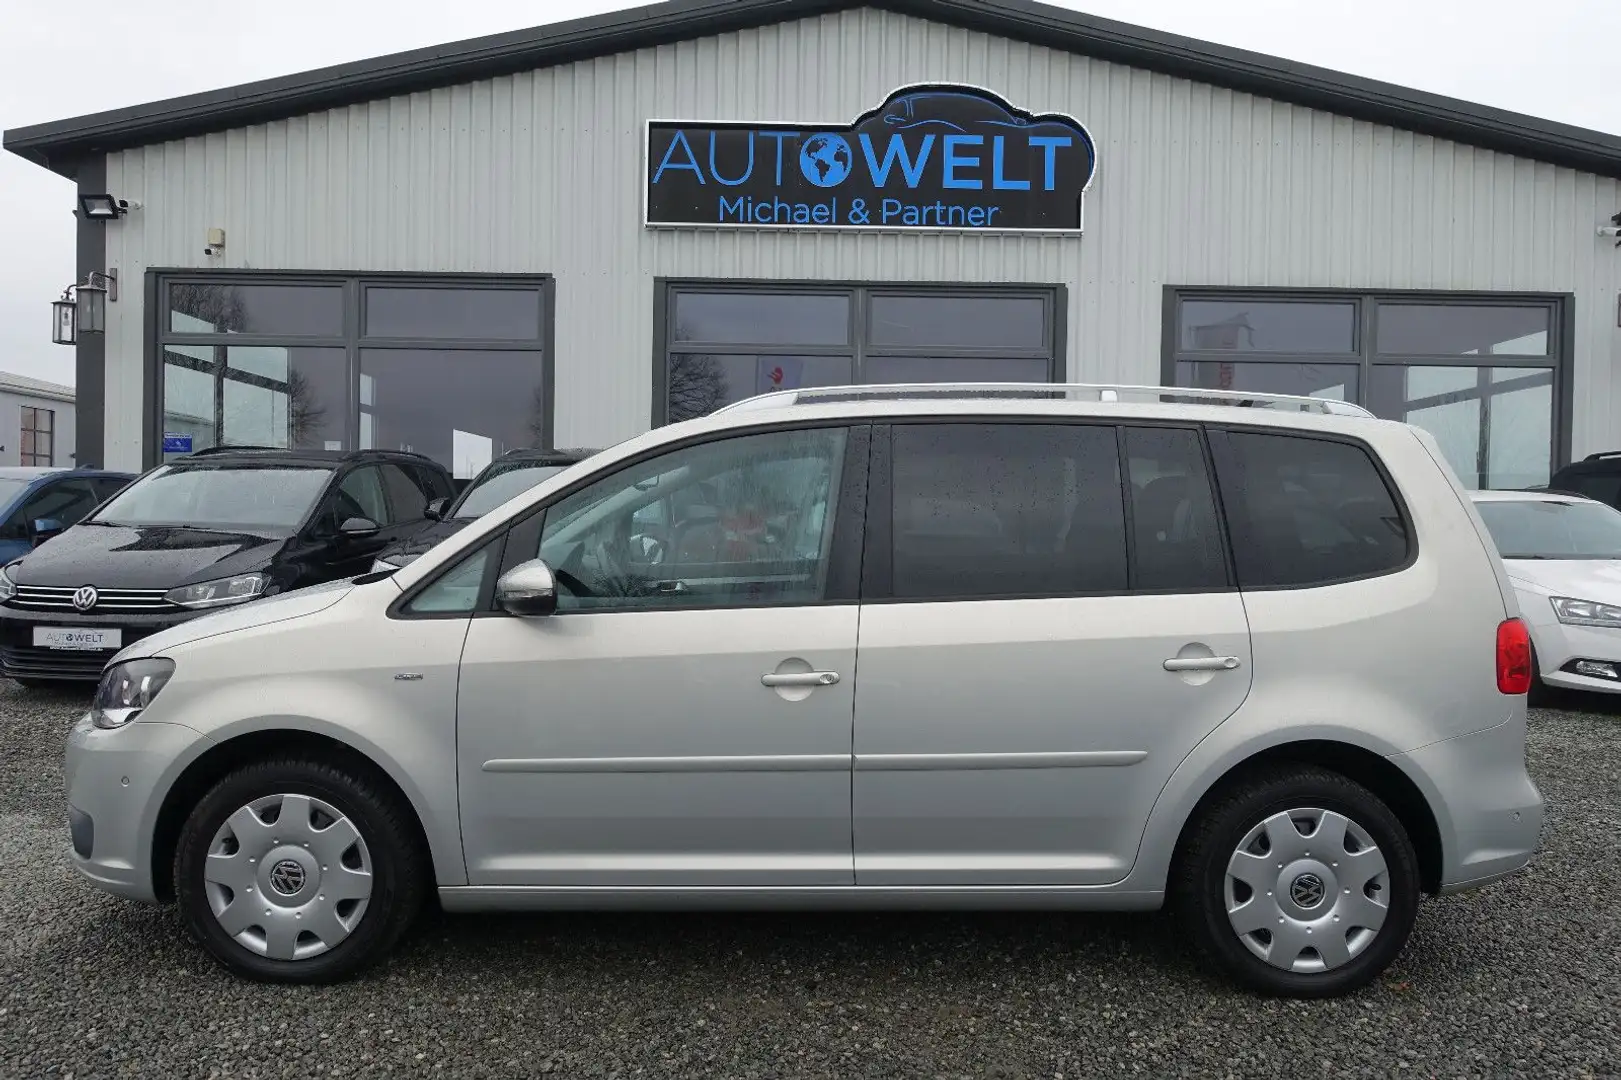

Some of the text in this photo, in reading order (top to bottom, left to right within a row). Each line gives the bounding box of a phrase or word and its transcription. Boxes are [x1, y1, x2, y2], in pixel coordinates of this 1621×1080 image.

[719, 195, 999, 226] Michael & Partner
